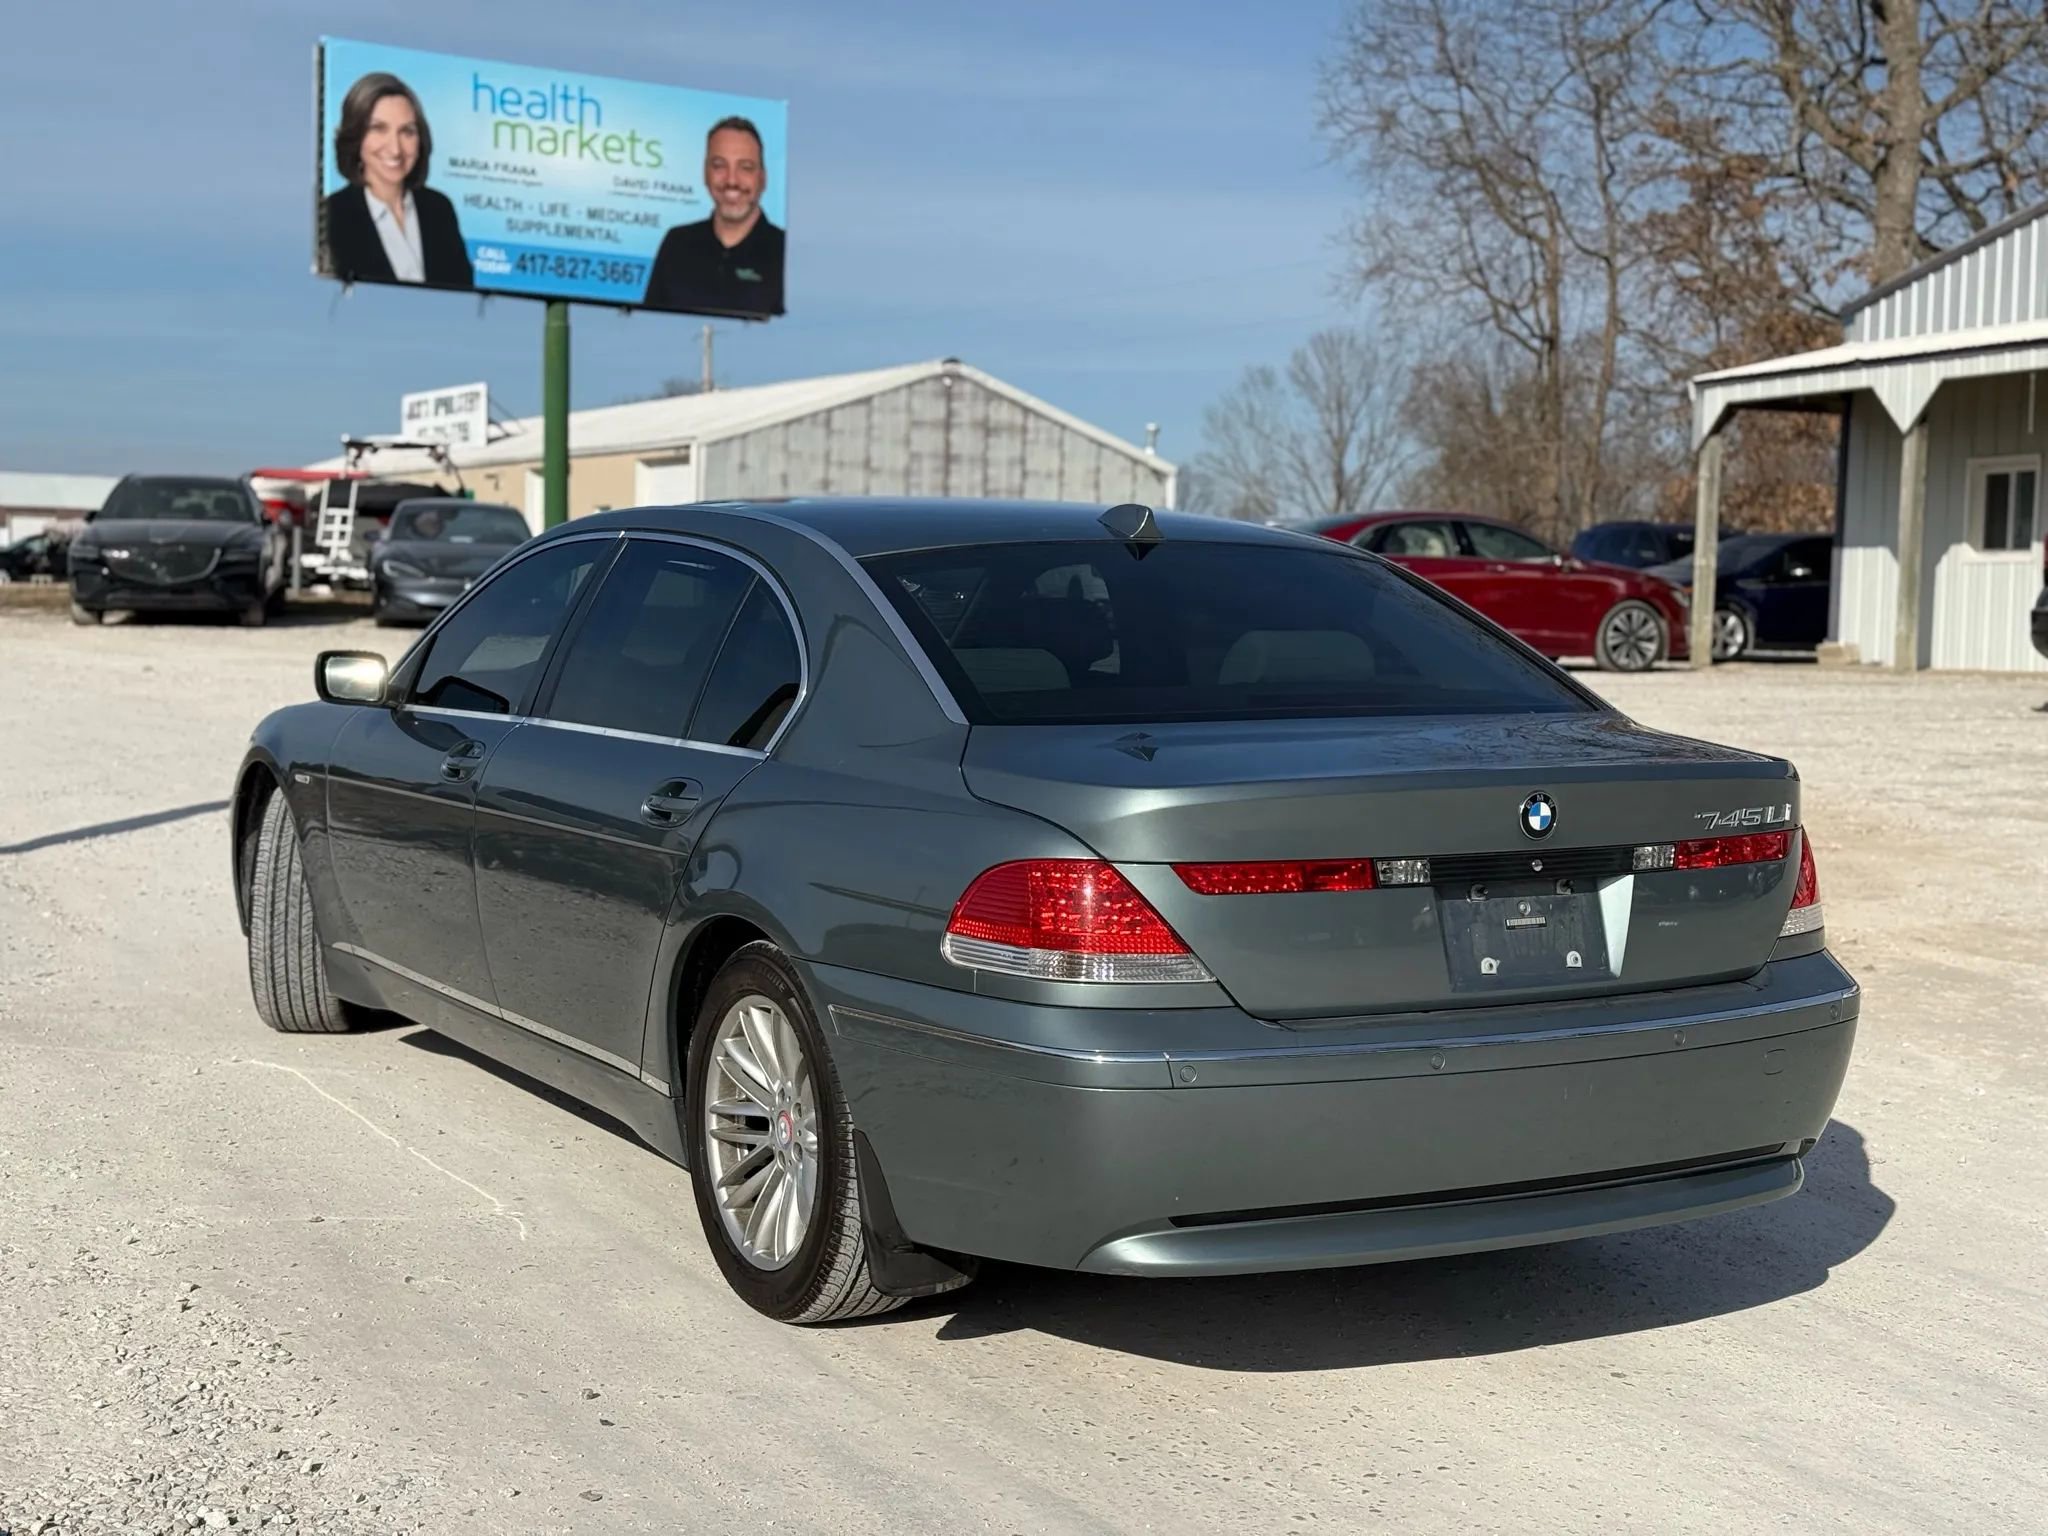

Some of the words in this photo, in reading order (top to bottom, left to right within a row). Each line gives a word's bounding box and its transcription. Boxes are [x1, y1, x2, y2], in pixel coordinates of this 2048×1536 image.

[473, 72, 602, 127] health
[493, 119, 664, 169] markets
[464, 194, 522, 212] HEALTH
[539, 202, 569, 217] LIFE
[587, 207, 660, 229] MEDICARE
[506, 217, 622, 243] SUPPLEMENTAL
[516, 252, 646, 286] 417-827-3667
[1525, 794, 1555, 809] BMW
